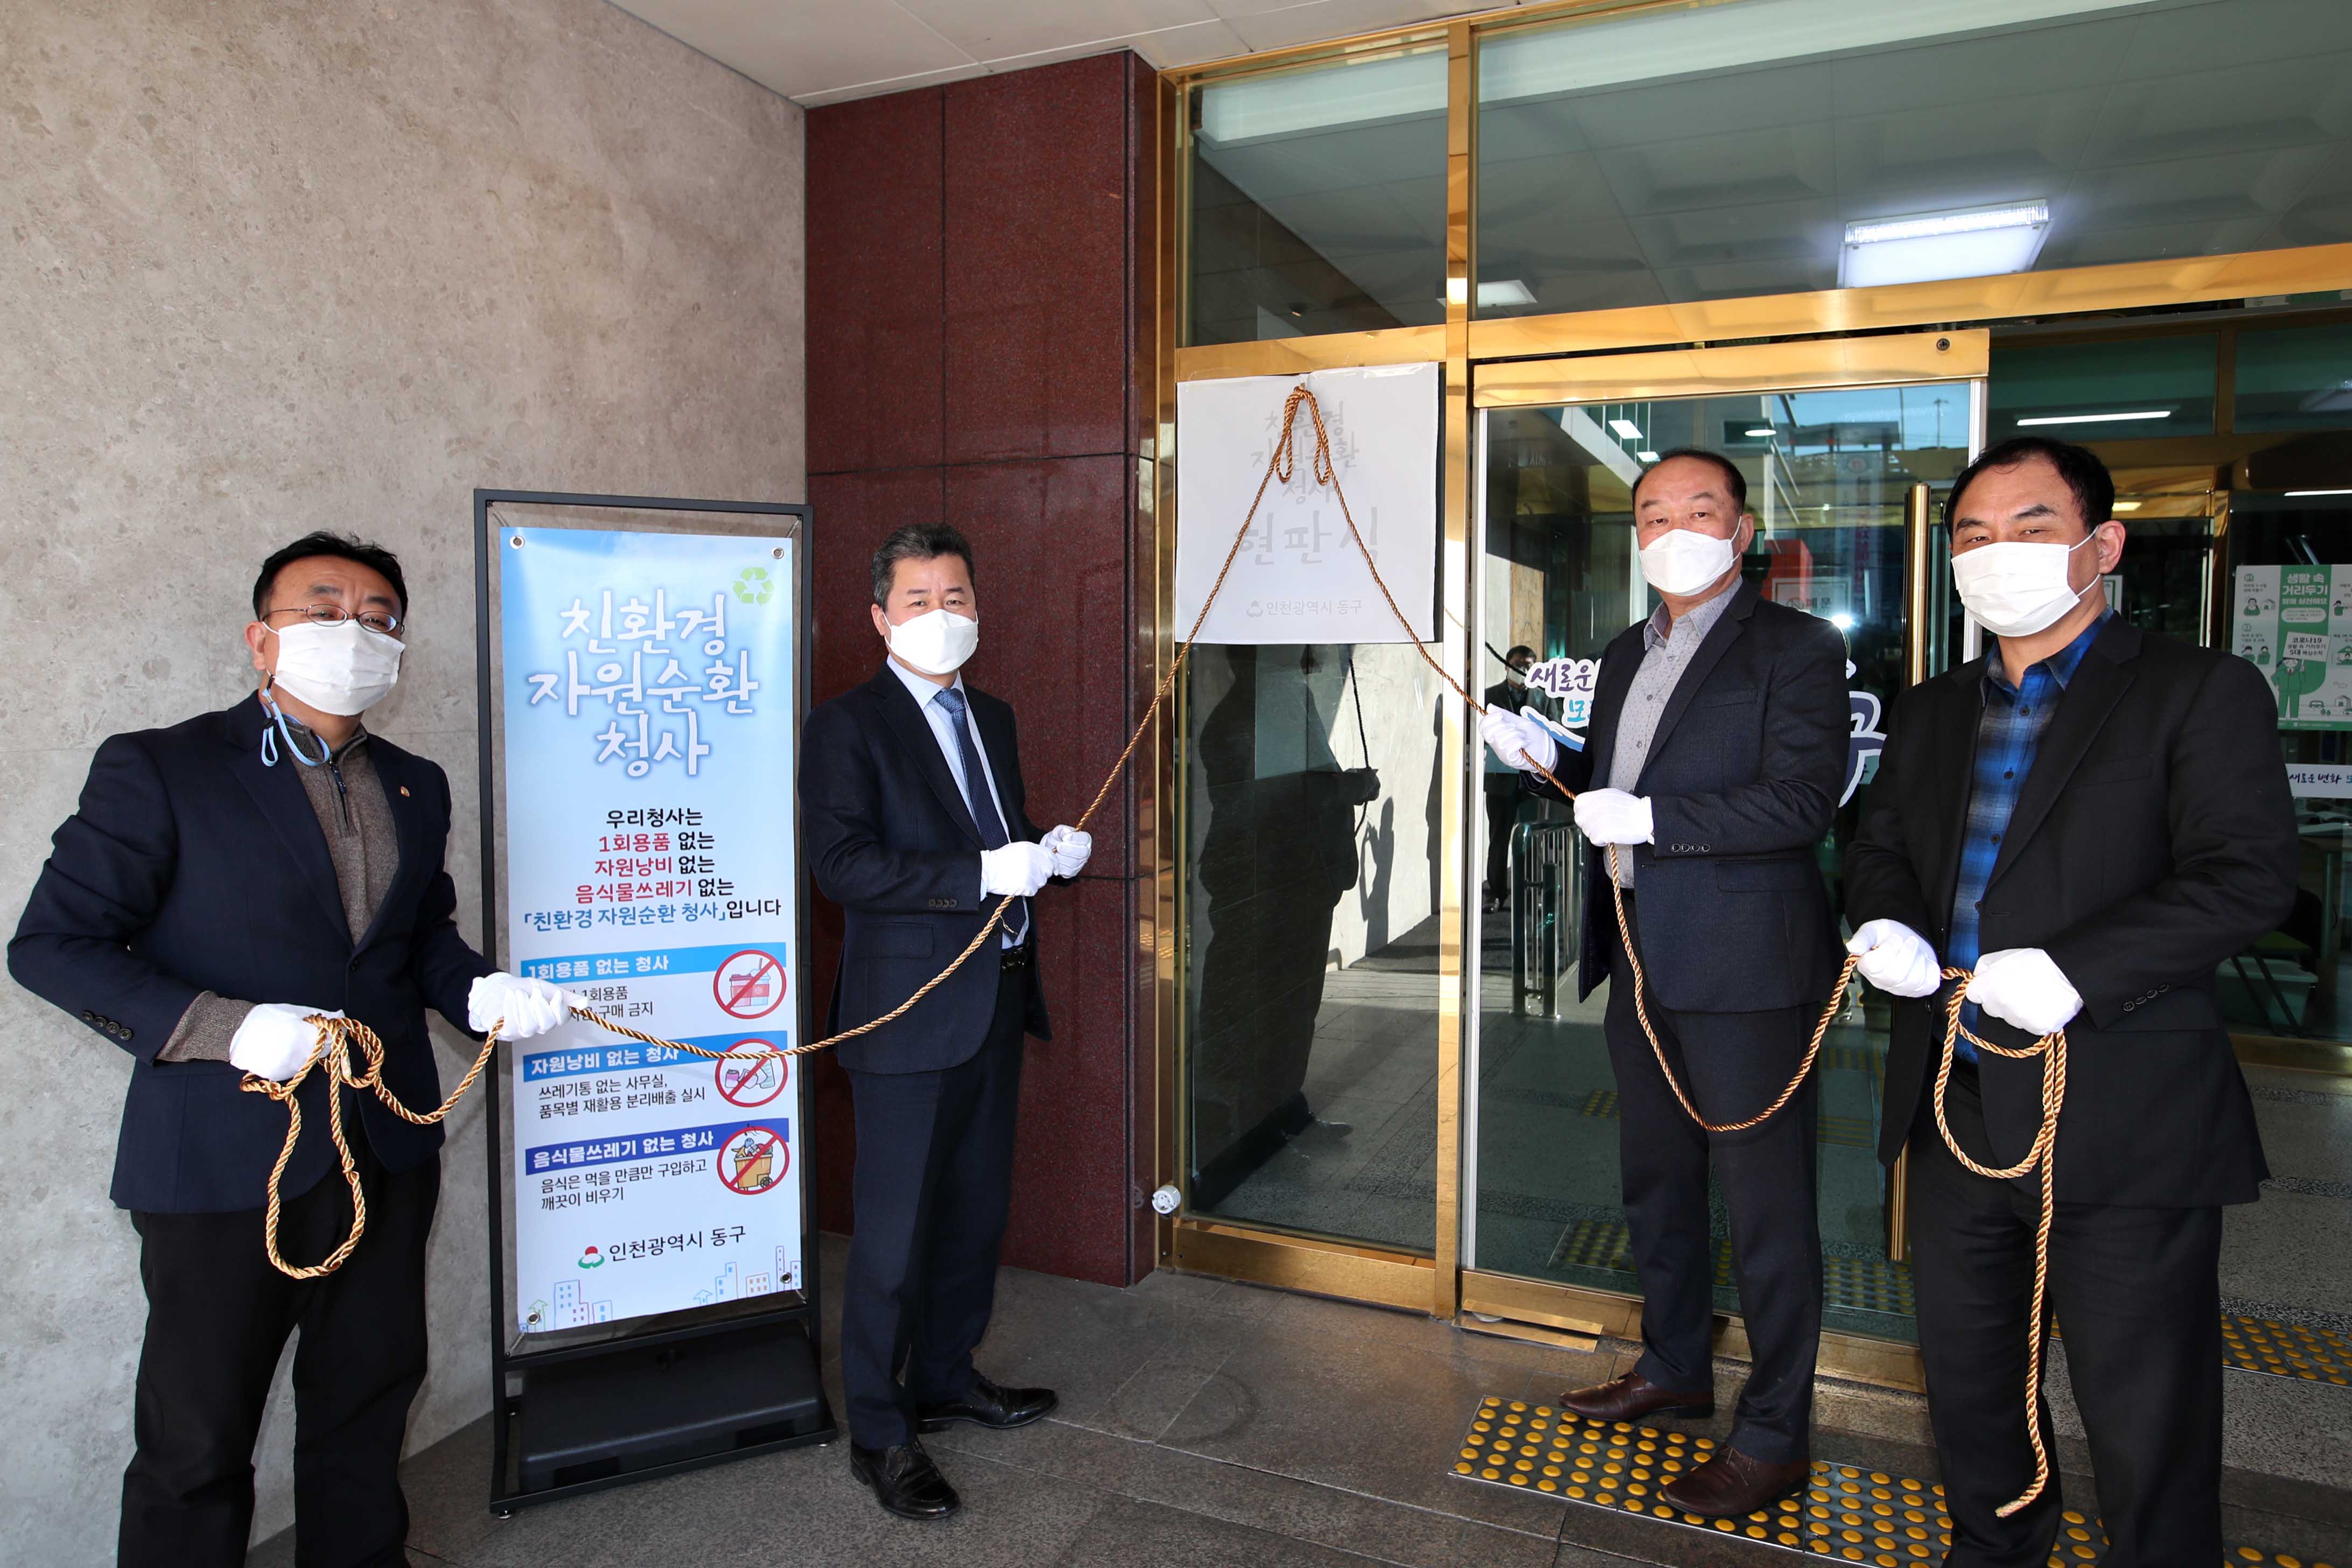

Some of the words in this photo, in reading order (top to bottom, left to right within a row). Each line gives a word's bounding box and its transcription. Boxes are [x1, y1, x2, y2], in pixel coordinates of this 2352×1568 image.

[2283, 585, 2328, 595] 거리두기
[1266, 600, 1332, 615] 인천광역시
[1337, 600, 1362, 615] 동구
[560, 589, 725, 655] 친환경
[528, 650, 758, 716] 자원순환
[1530, 663, 1594, 692] 새로운
[597, 711, 709, 776] 청사
[2288, 773, 2315, 783] 새로운
[2318, 773, 2342, 784] 변화
[606, 808, 703, 829] 우리청사는
[598, 832, 670, 852] 1회용품
[678, 831, 715, 851] 없는
[594, 856, 673, 877] 자원낭비
[678, 855, 715, 874] 없는
[575, 879, 692, 904] 음식물쓰레기
[698, 878, 734, 897] 없는
[598, 904, 676, 926] 자원순환
[528, 961, 589, 979] 1회용품
[596, 958, 629, 975] 없는
[635, 955, 669, 971] 청사
[582, 986, 628, 1002] 1회용품
[628, 1001, 653, 1017] 금지
[531, 1053, 600, 1075] 자원낭비
[606, 1049, 640, 1066] 없는
[646, 1047, 680, 1062] 청사
[539, 1081, 591, 1100] 쓰레기통
[596, 1079, 621, 1094] 없는
[626, 1074, 667, 1090] 사무실,
[539, 1101, 578, 1119] 품목별
[583, 1096, 622, 1112] 재활용
[626, 1090, 676, 1108] 분리배출
[681, 1087, 705, 1103] 실시
[533, 1140, 636, 1168] 음식물쓰레기
[642, 1136, 675, 1154] 없는
[681, 1131, 713, 1149] 청사
[541, 1175, 580, 1194] 음식은
[585, 1170, 611, 1186] 먹을
[615, 1166, 653, 1183] 만큼만
[657, 1159, 707, 1178] 구입하고
[541, 1192, 580, 1210] 깨끗이
[586, 1187, 624, 1204] 비우기
[609, 1231, 702, 1262] 인천광역시
[710, 1226, 746, 1247] 동구
